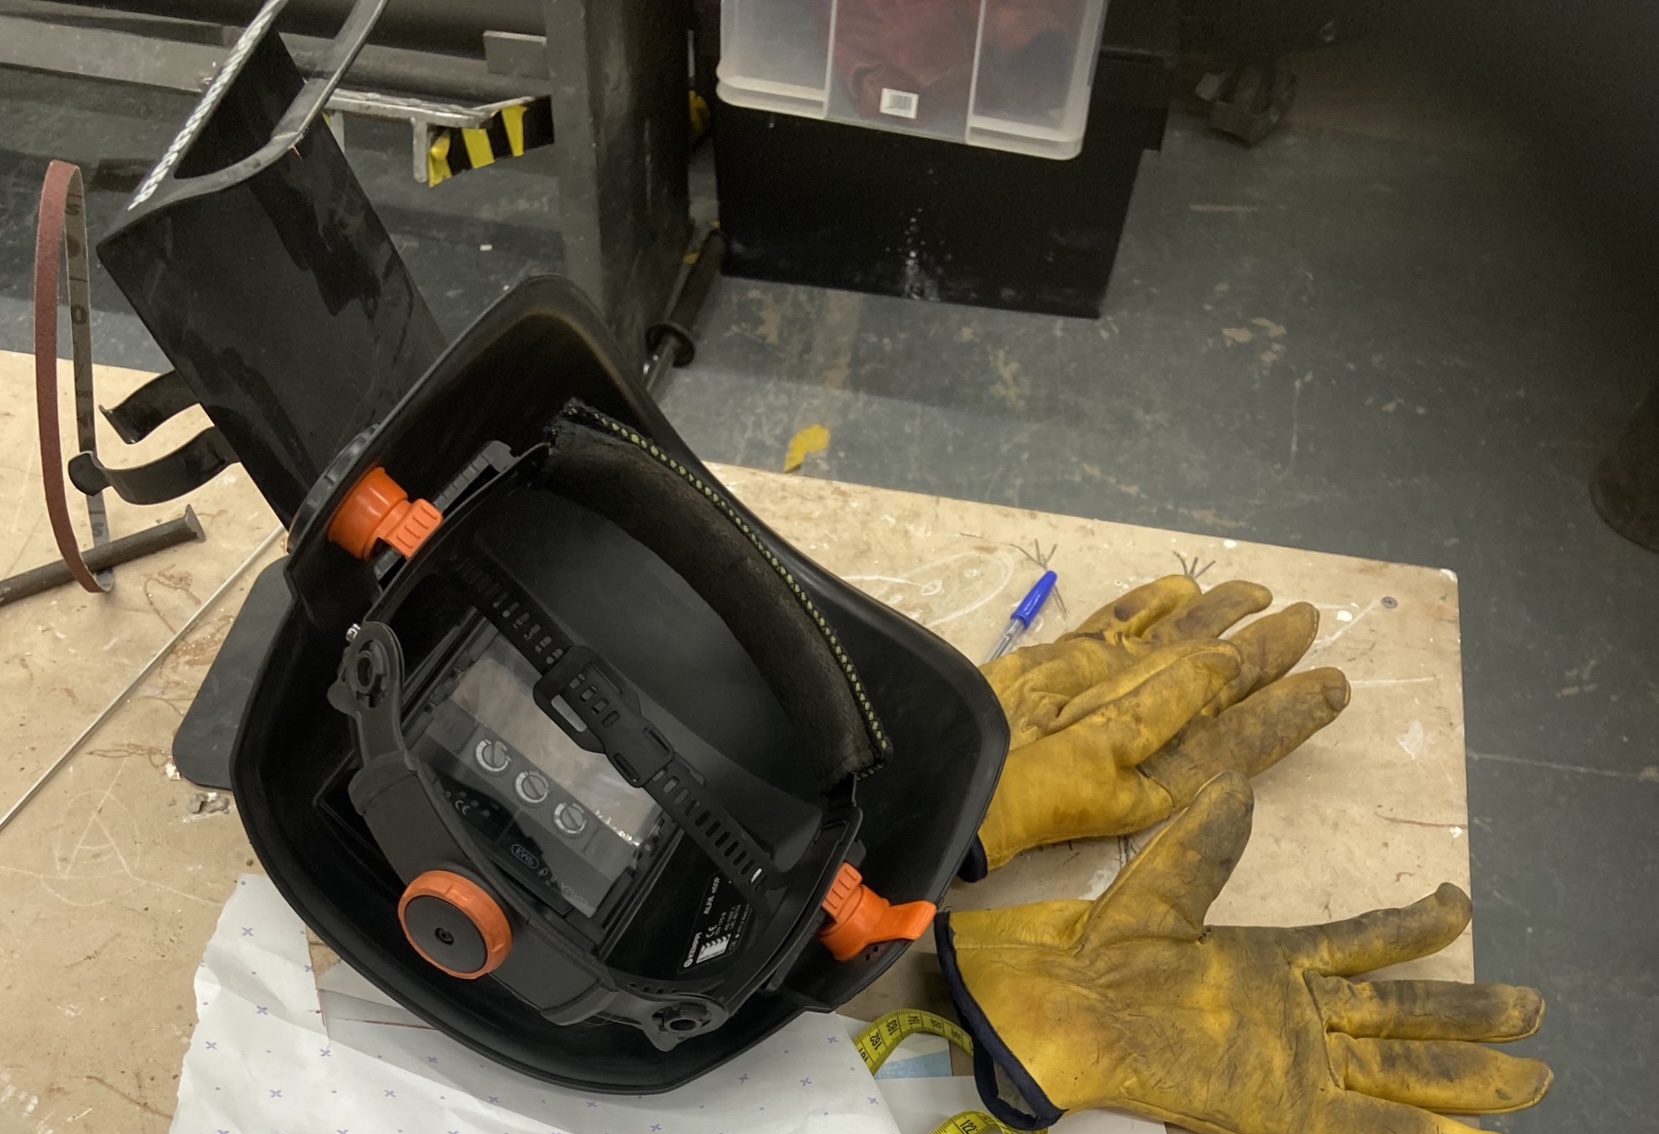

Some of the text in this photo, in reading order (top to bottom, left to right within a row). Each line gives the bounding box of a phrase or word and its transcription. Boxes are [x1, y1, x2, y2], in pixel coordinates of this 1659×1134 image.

[703, 895, 715, 914] ALFA
[706, 924, 717, 938] CE
[869, 1032, 883, 1050] 162
[886, 1019, 899, 1035] 163
[960, 1119, 977, 1134] 122
